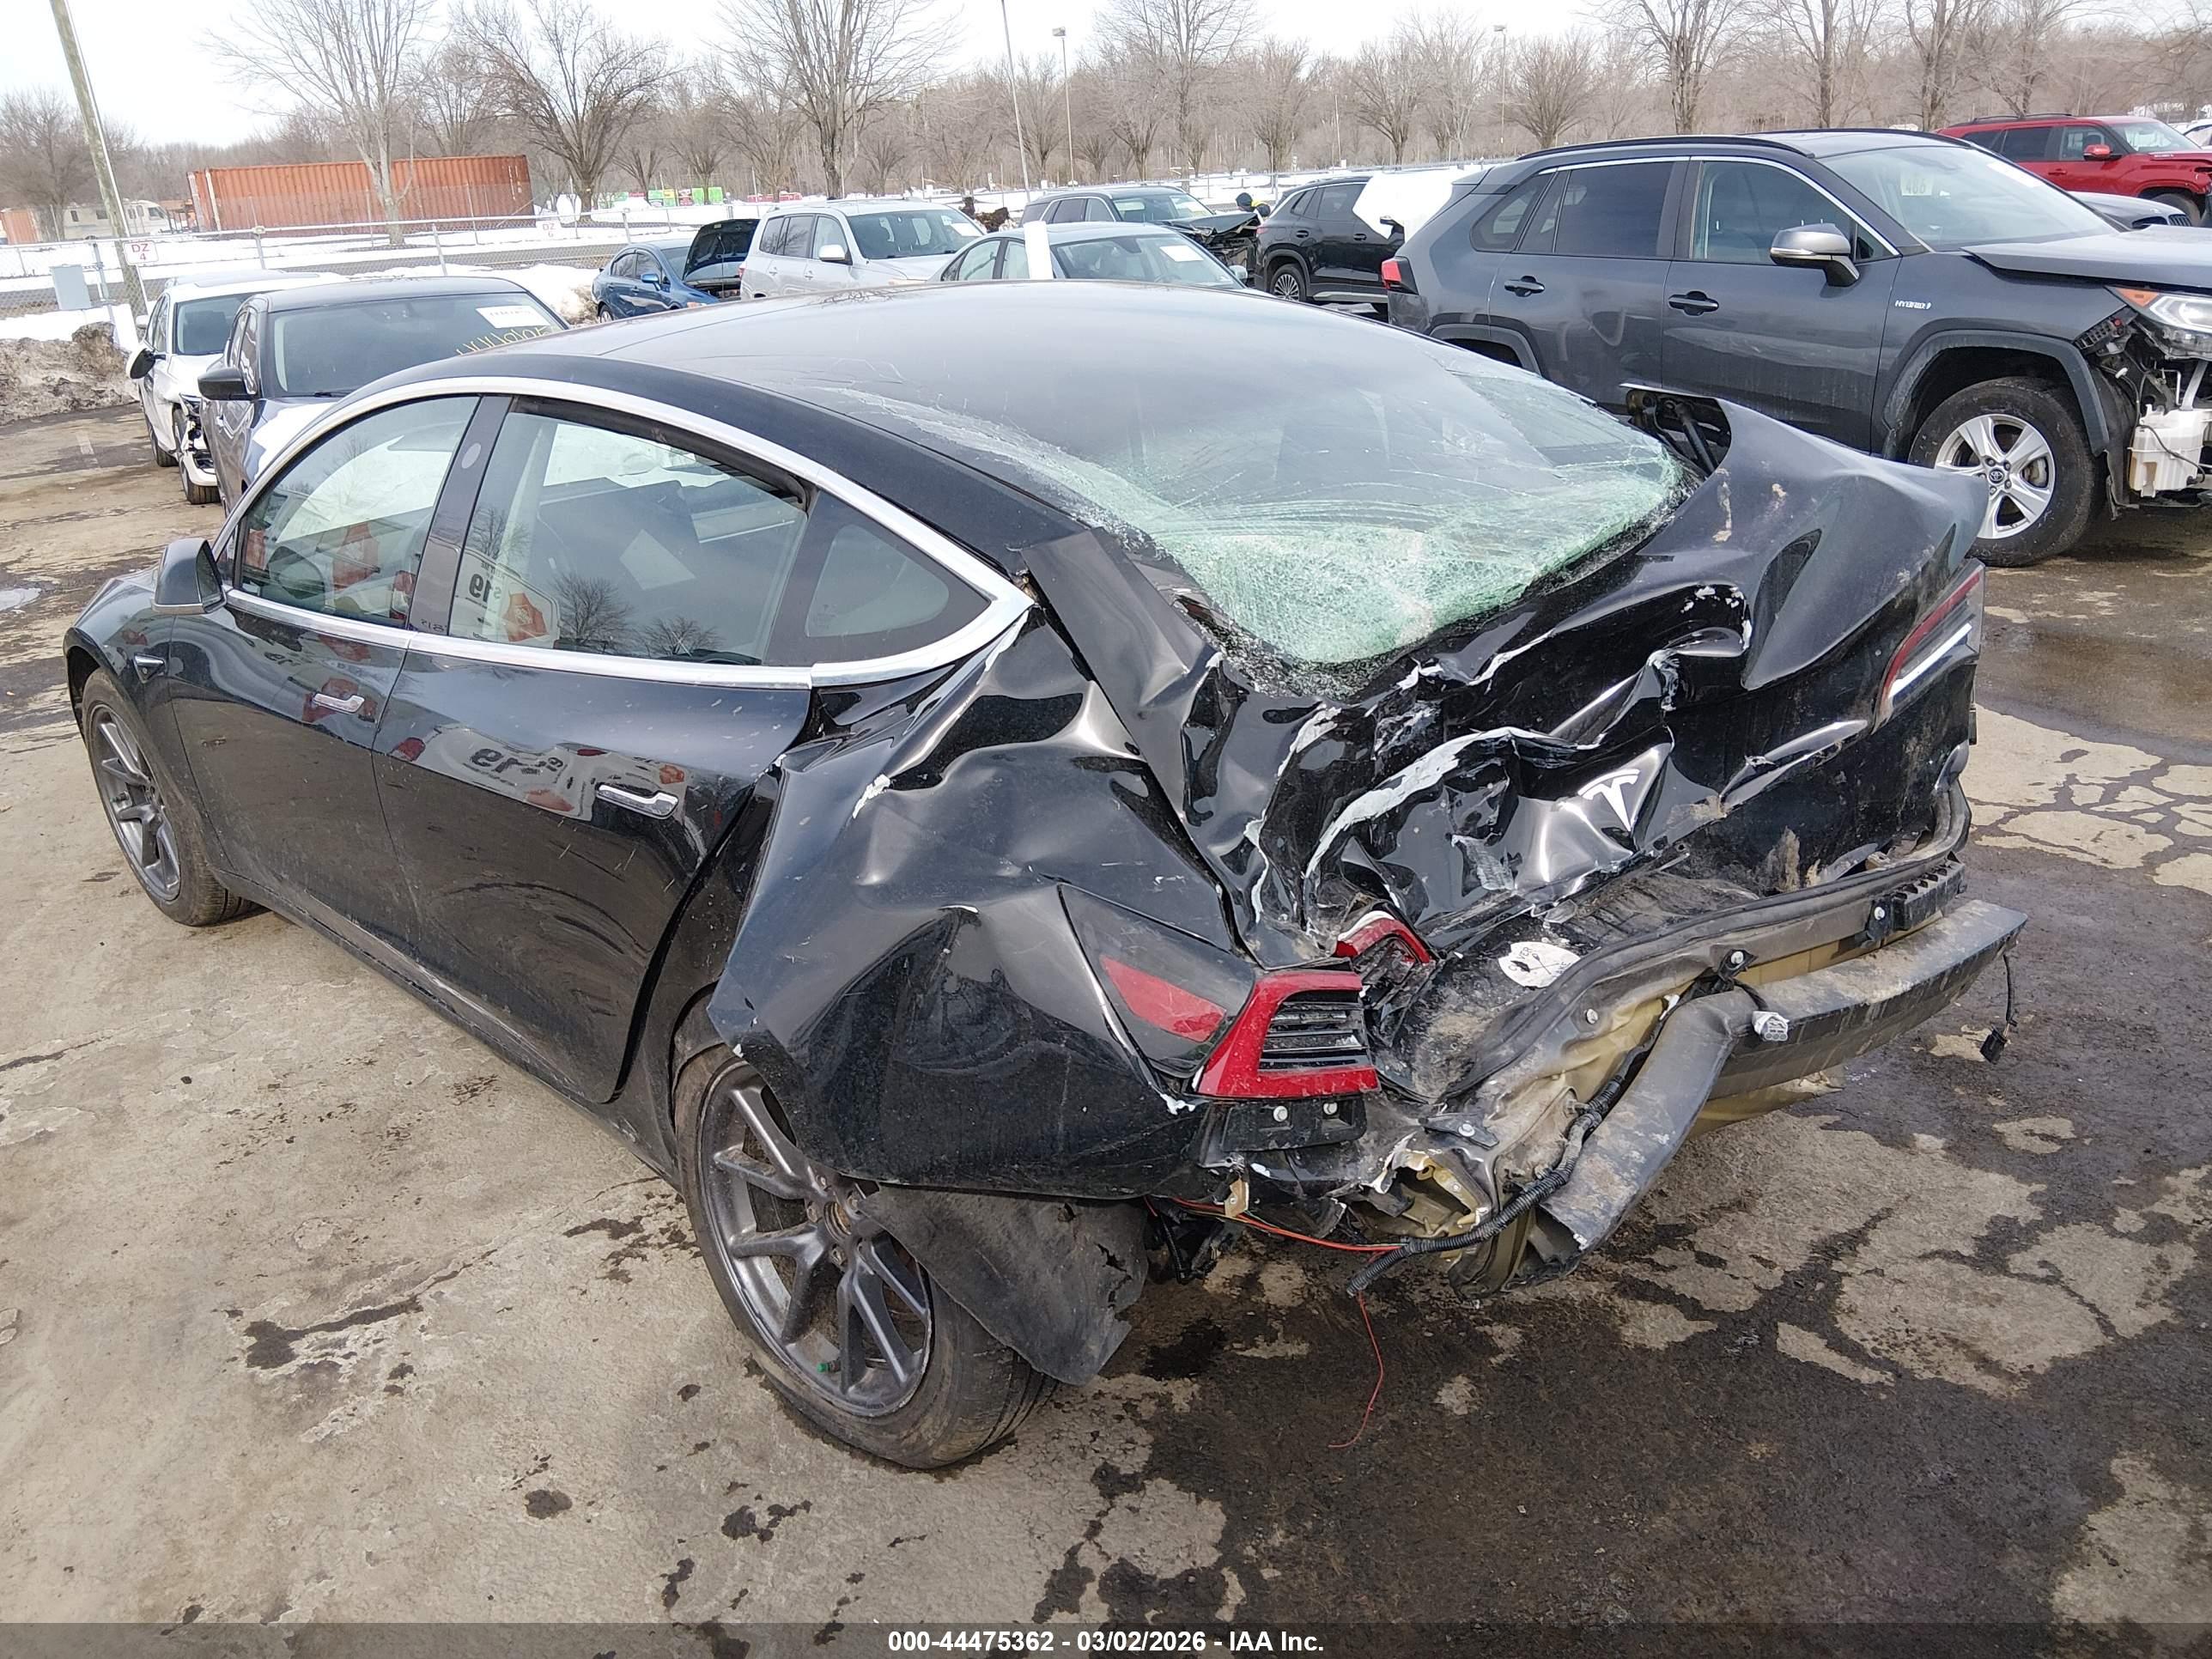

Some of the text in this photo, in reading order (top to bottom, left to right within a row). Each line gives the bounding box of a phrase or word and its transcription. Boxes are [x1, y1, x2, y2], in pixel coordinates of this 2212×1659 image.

[131, 244, 150, 252] DZ
[139, 252, 147, 261] 4
[1894, 300, 1925, 309] HYBRID
